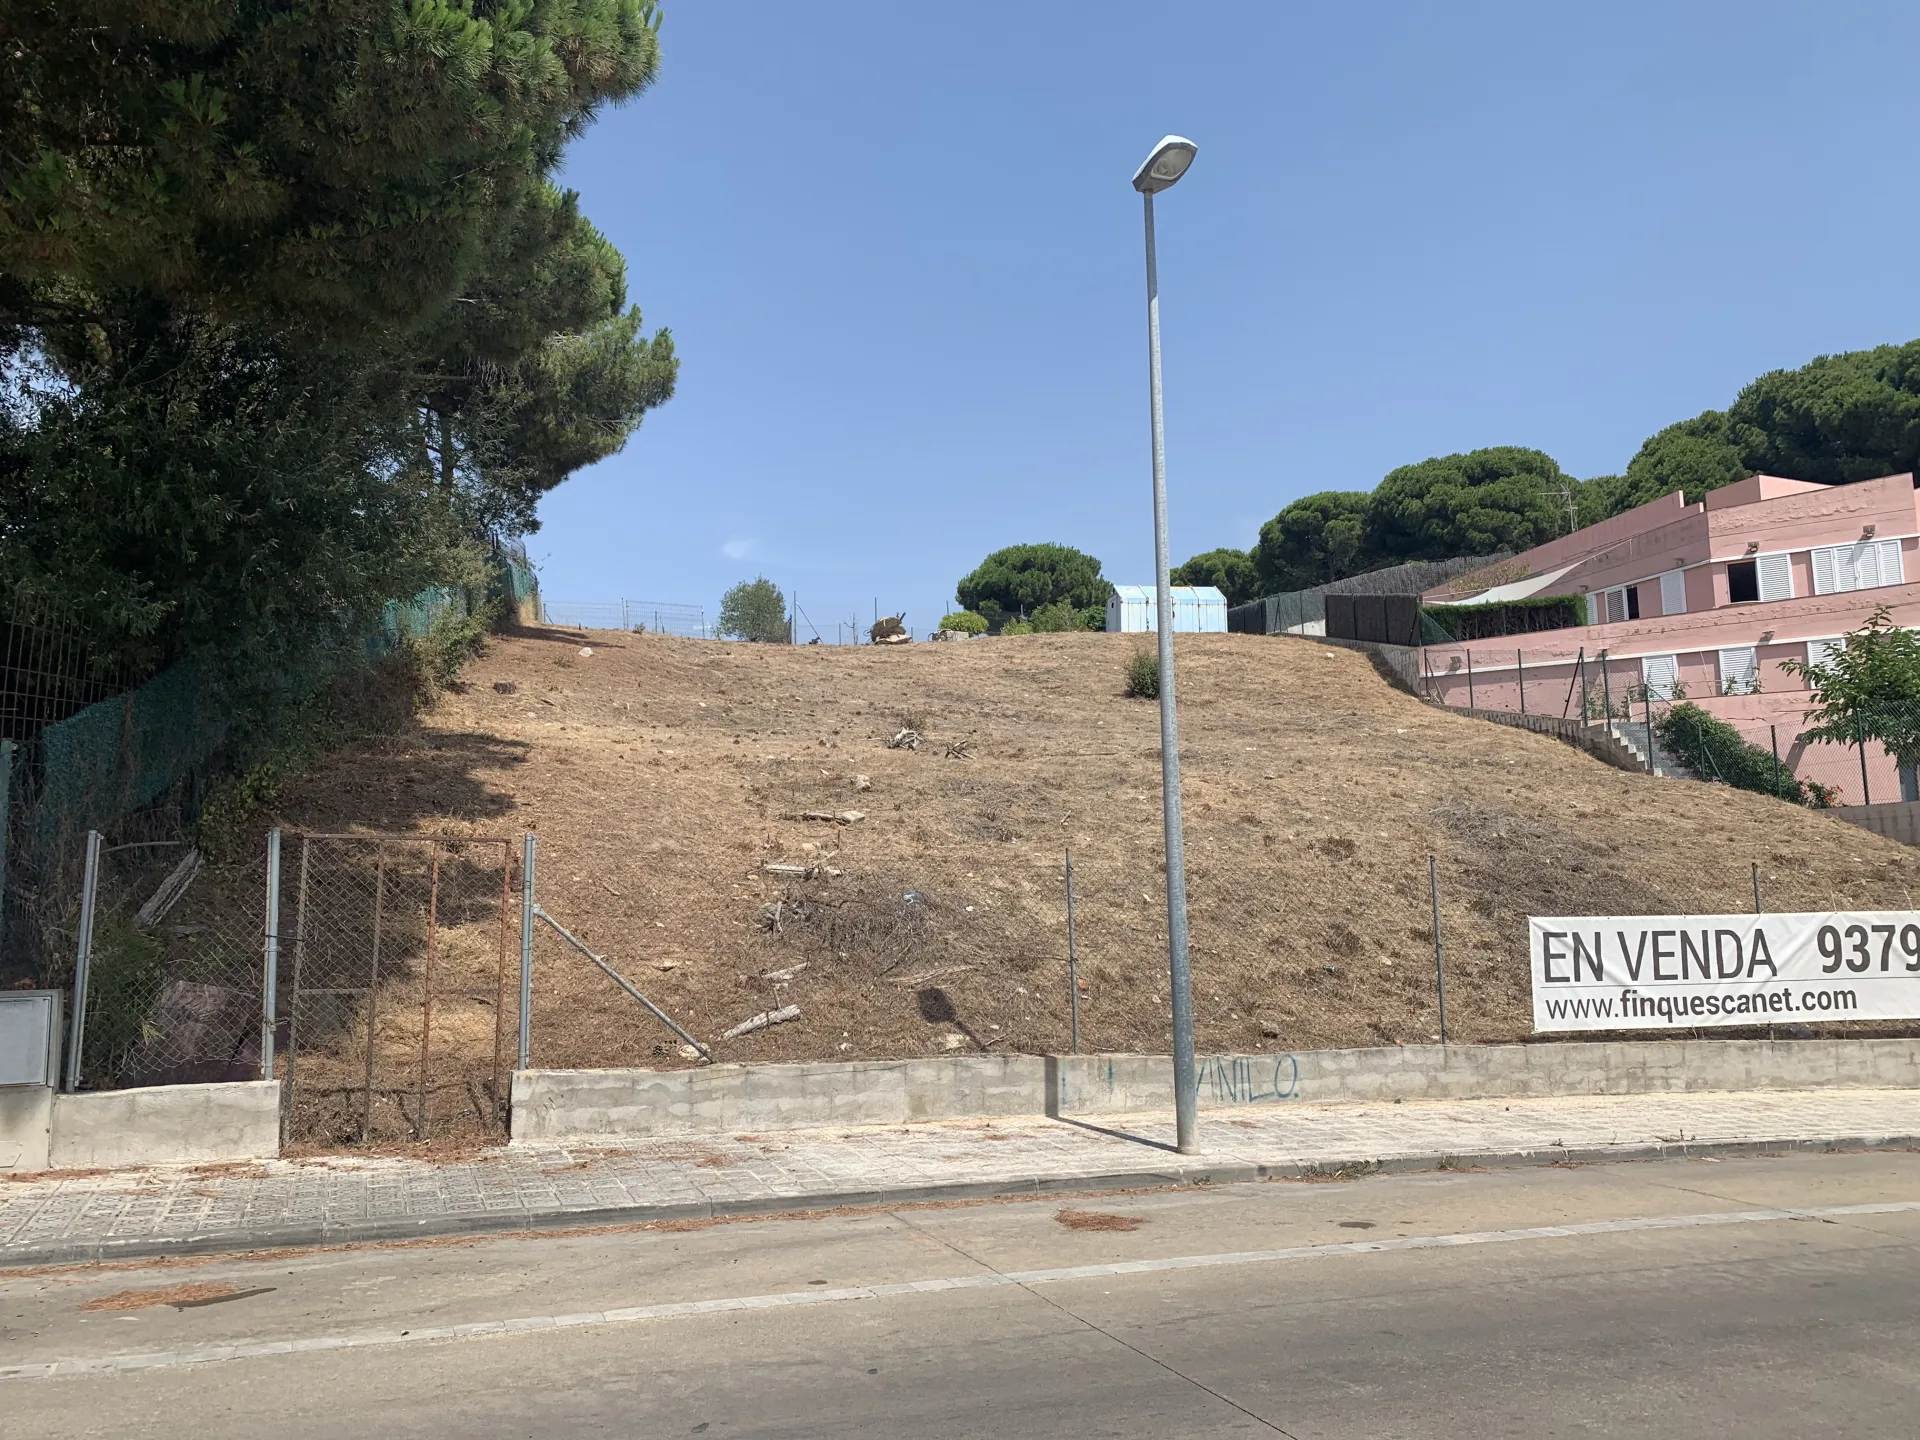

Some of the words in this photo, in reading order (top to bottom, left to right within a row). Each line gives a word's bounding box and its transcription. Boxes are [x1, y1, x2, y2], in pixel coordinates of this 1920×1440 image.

[1542, 931, 1604, 983] EN
[1617, 928, 1778, 981] VENDA
[1816, 924, 1920, 974] 9379
[1545, 988, 1857, 1024] www.finquescanet.com
